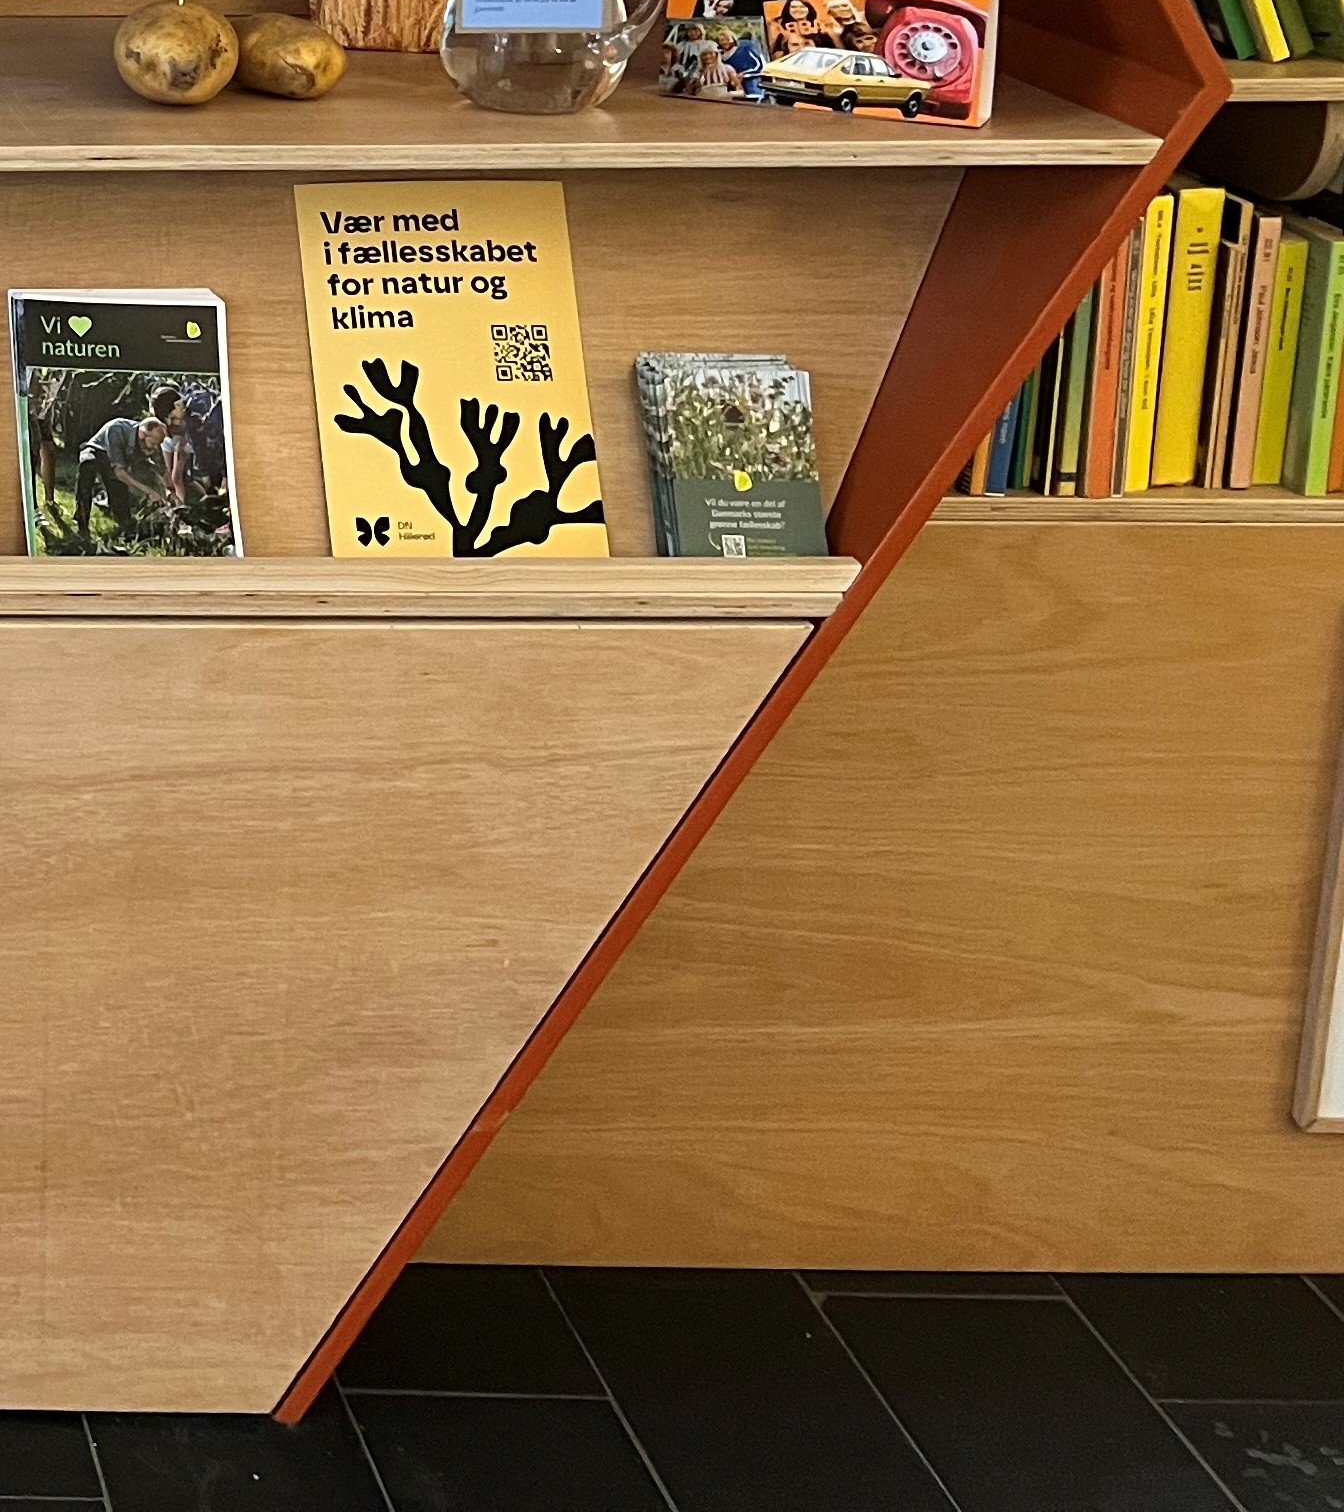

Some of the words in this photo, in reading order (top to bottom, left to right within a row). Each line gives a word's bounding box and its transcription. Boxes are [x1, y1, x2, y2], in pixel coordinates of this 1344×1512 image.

[319, 210, 386, 234] Vær
[392, 208, 460, 232] med
[337, 239, 538, 265] fællesskabet
[326, 273, 374, 296] for
[381, 272, 464, 295] natur
[470, 275, 508, 300] og
[40, 315, 61, 335] Vi
[331, 304, 414, 330] klima
[42, 339, 120, 358] naturen
